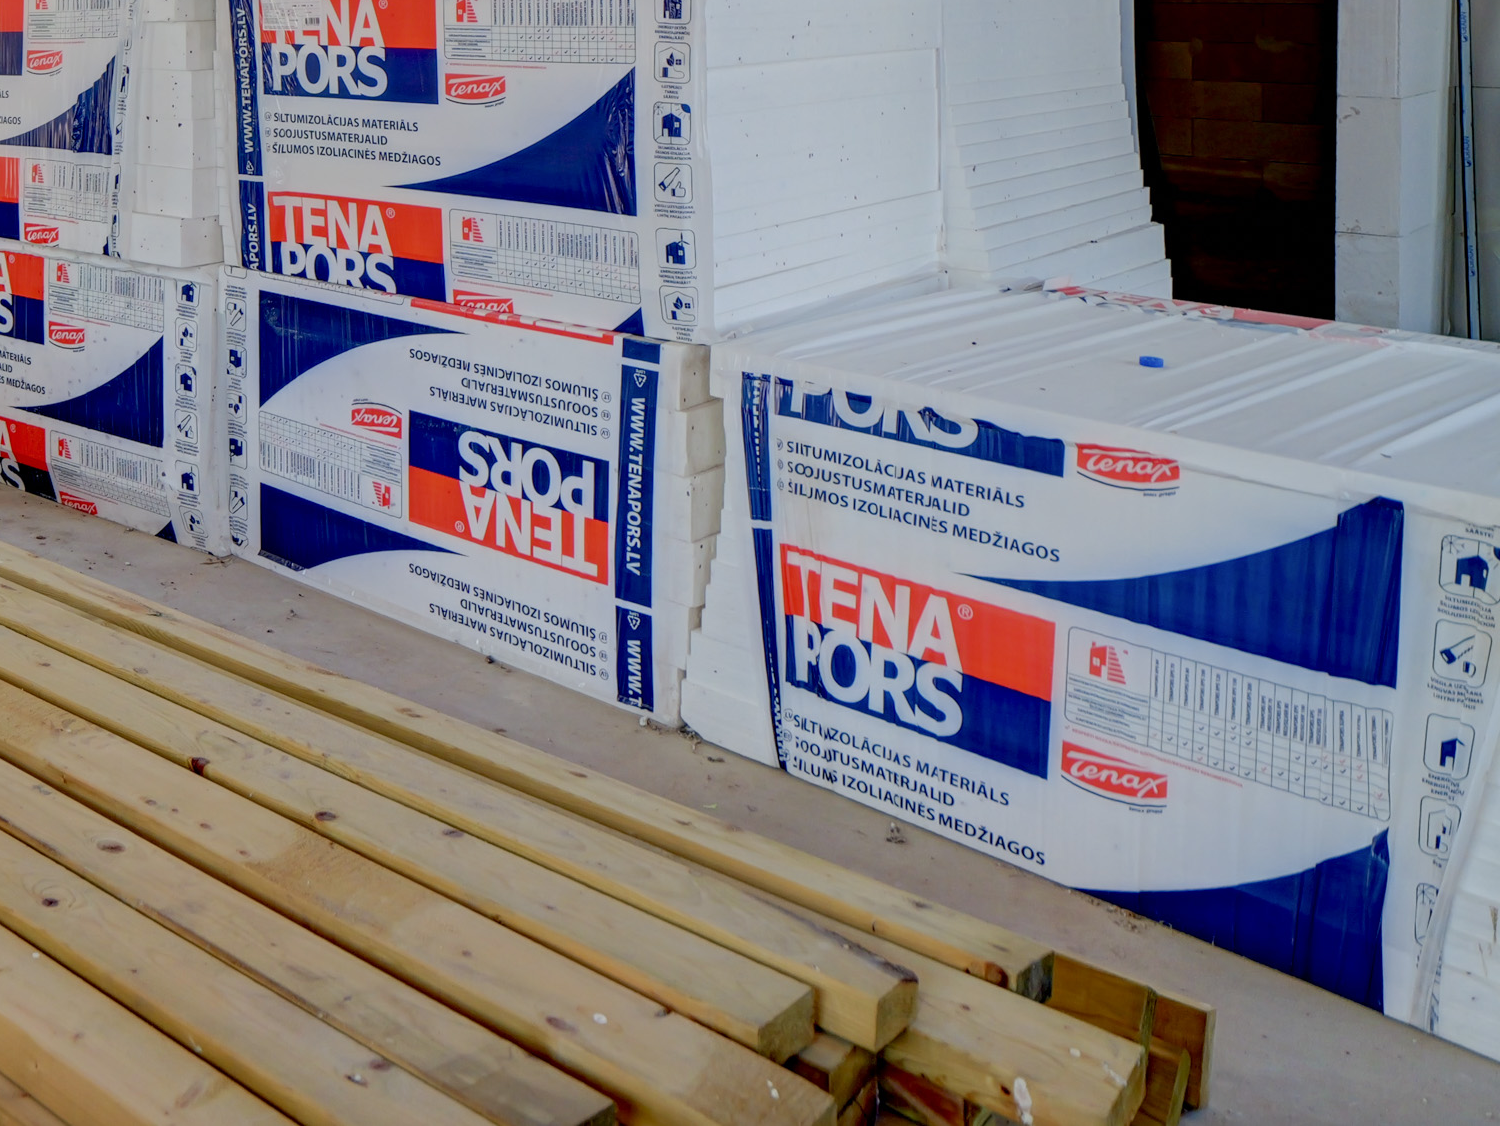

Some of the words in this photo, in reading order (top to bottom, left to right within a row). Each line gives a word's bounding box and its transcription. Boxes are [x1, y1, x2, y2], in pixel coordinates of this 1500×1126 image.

[236, 8, 254, 153] WWW.TENAPORS.LV
[272, 44, 388, 97] PORS
[273, 112, 360, 128] SILTUMIZOLĀCIJAS
[362, 118, 419, 132] MATERIĀLS
[273, 129, 388, 145] SOOJUSTUSMATERJALID
[272, 143, 314, 155] ŠILUMOS
[316, 146, 376, 160] IZOLIACINĖS
[378, 151, 441, 166] MEDŽIAGOS
[409, 349, 470, 372] MEDŽIAGOS
[474, 363, 542, 387] IZOLIACINĖS
[6, 376, 46, 395] MEDŽIAGOS
[429, 386, 487, 409] MATERIĀLS
[461, 377, 598, 417] SOOJUSTUSMATERJALID
[545, 378, 599, 399] ŠILUMOS
[490, 401, 597, 435] SILTUMIZOLĀCIJAS
[458, 430, 595, 518] PORS
[626, 396, 646, 576] WWW.TENAPORS.LV
[931, 474, 1025, 509] MATERIĀLS
[953, 523, 1061, 564] MEDŽIAGOS
[409, 563, 470, 595] MEDŽIAGOS
[429, 603, 487, 634] MATERIĀLS
[473, 586, 541, 620] IZOLIACINĖS
[460, 598, 596, 657] SOOJUSTUSMATERJALID
[544, 612, 596, 640] ŠILUMOS
[490, 625, 597, 676] SILTUMIZOLĀCIJAS
[794, 621, 964, 737] PORS
[916, 759, 1011, 806] MATERIĀLS
[841, 774, 935, 821] IZOLIACINĖS
[938, 812, 1046, 866] MEDŽIAGOS
